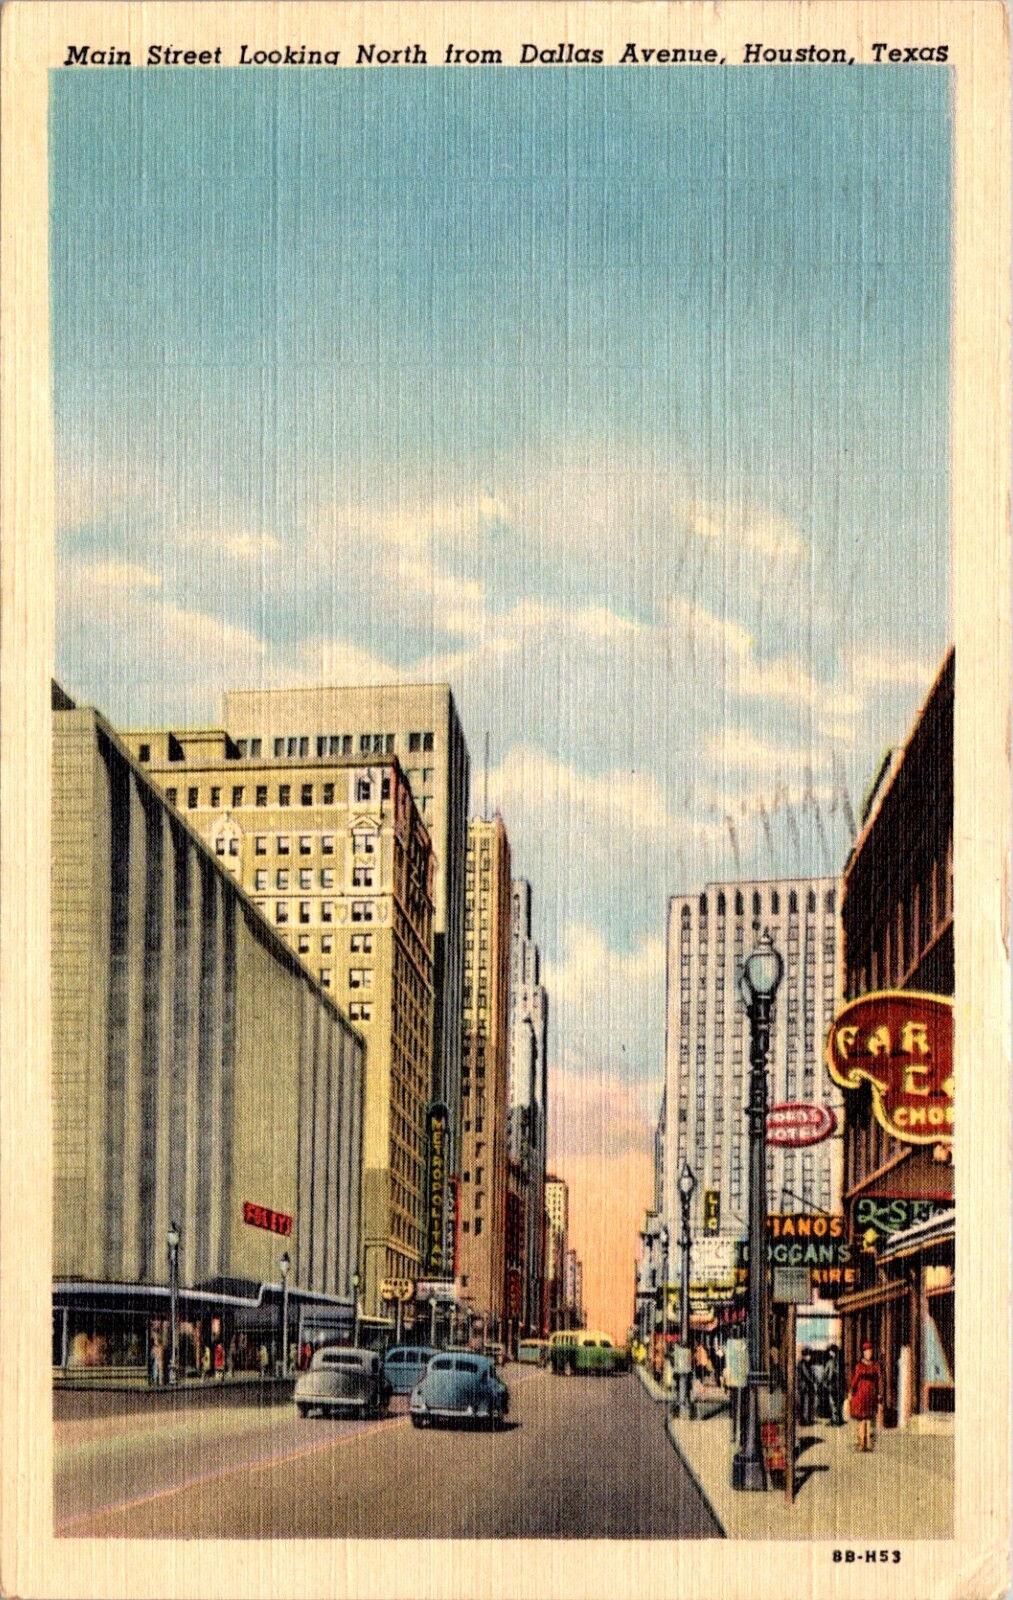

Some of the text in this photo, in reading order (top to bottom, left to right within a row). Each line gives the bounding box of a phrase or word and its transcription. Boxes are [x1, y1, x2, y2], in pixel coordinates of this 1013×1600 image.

[64, 45, 132, 65] Main
[147, 44, 222, 65] Street
[356, 44, 427, 64] North
[445, 44, 503, 64] from
[519, 43, 604, 64] Dallas
[619, 43, 726, 66] Avenue,
[743, 43, 855, 66] Houston,
[872, 43, 949, 64] Texas
[836, 1020, 930, 1060] FAR
[431, 1114, 445, 1267] METROPOLITAN
[767, 1217, 842, 1238] IANOS
